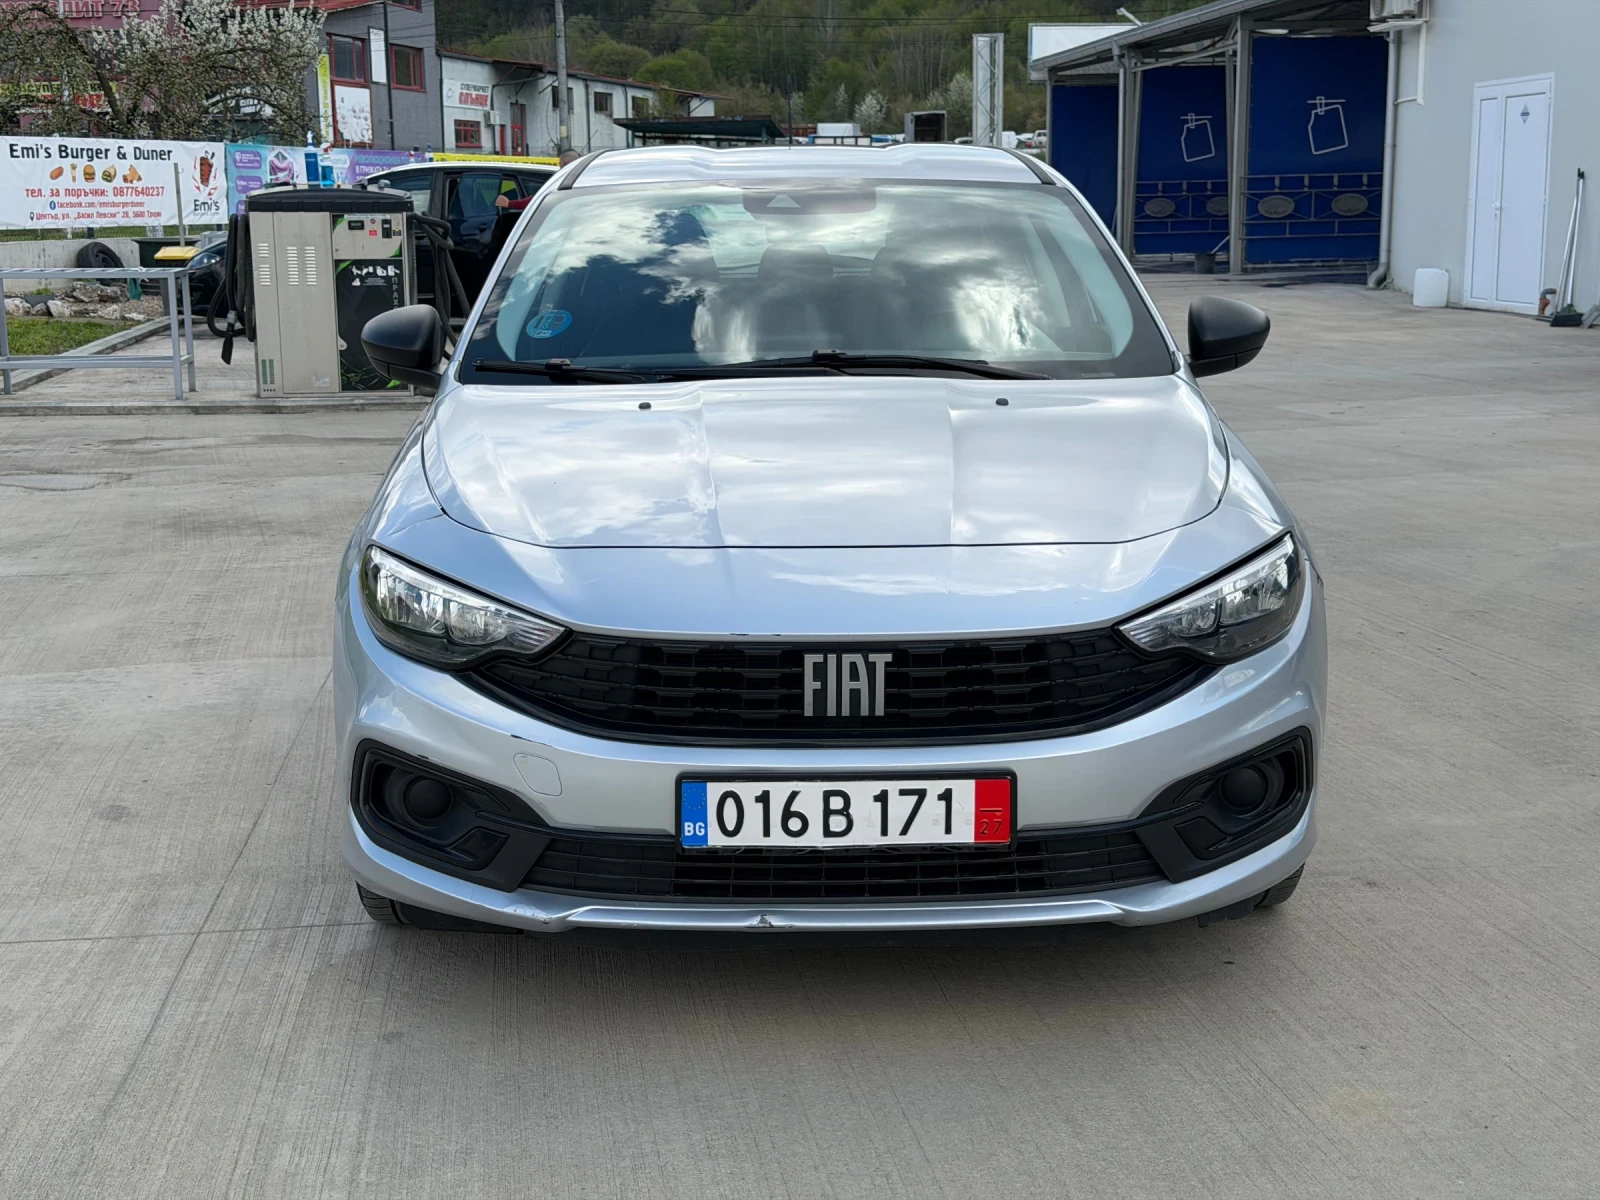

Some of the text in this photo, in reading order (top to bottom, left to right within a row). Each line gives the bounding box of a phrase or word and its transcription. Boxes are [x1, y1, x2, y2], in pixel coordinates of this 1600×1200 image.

[9, 143, 173, 162] Emi's Burger & Duner
[24, 186, 165, 199] тел. за поръчки: 0877640237
[193, 197, 220, 212] Emi's
[803, 653, 893, 717] FIAT
[715, 789, 810, 839] 016
[871, 787, 954, 838] 171
[683, 821, 706, 838] BG
[978, 818, 1004, 836] 27
